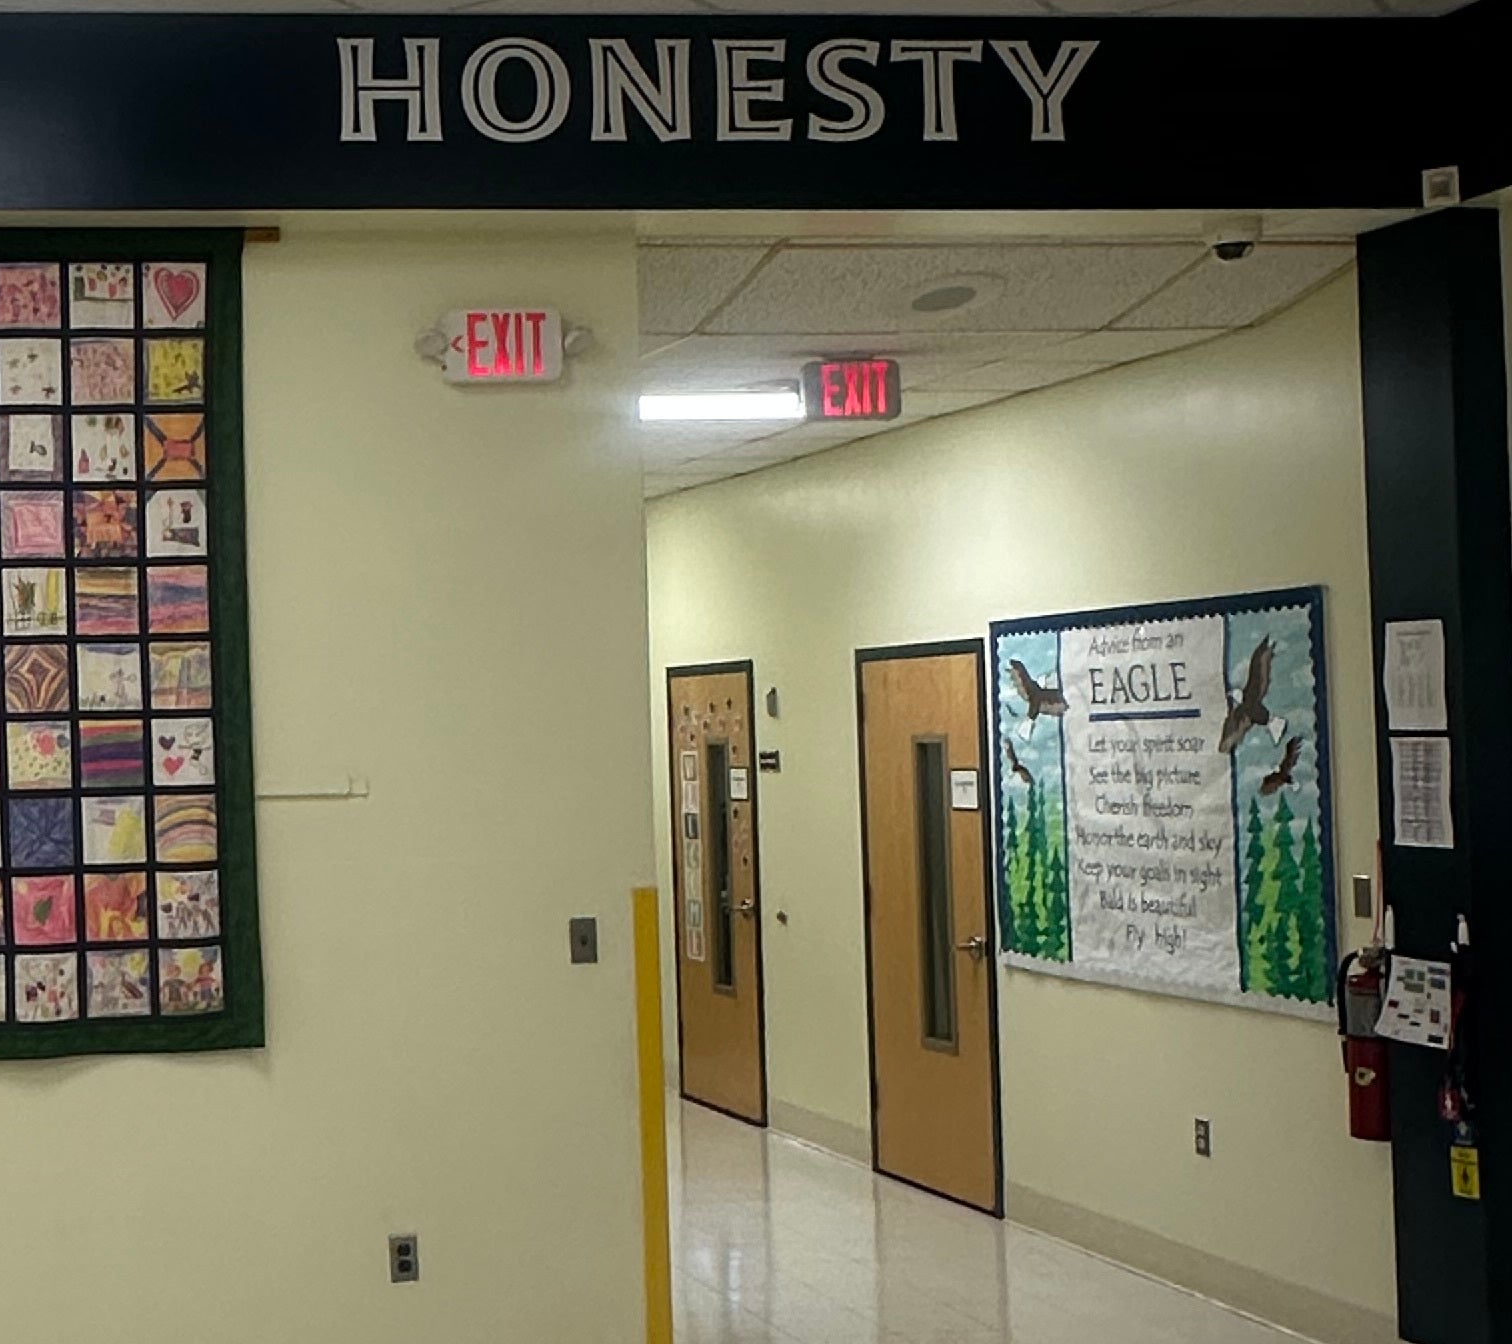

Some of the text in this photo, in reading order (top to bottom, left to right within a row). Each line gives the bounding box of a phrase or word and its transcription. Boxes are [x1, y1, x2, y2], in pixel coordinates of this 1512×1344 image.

[336, 36, 1101, 143] HONESTY
[466, 312, 546, 376] EXIT
[820, 361, 889, 417] EXIT
[1088, 626, 1184, 656] Advice from an
[1088, 662, 1192, 704] EAGLE
[1088, 734, 1205, 758] Let your spirit soar
[1089, 761, 1201, 792] See the big picture
[1074, 824, 1222, 858] Honor the earth and sky
[1078, 858, 1222, 893] Keep your goals in sight
[1140, 889, 1197, 917] beautiful
[1127, 923, 1146, 951] Fly
